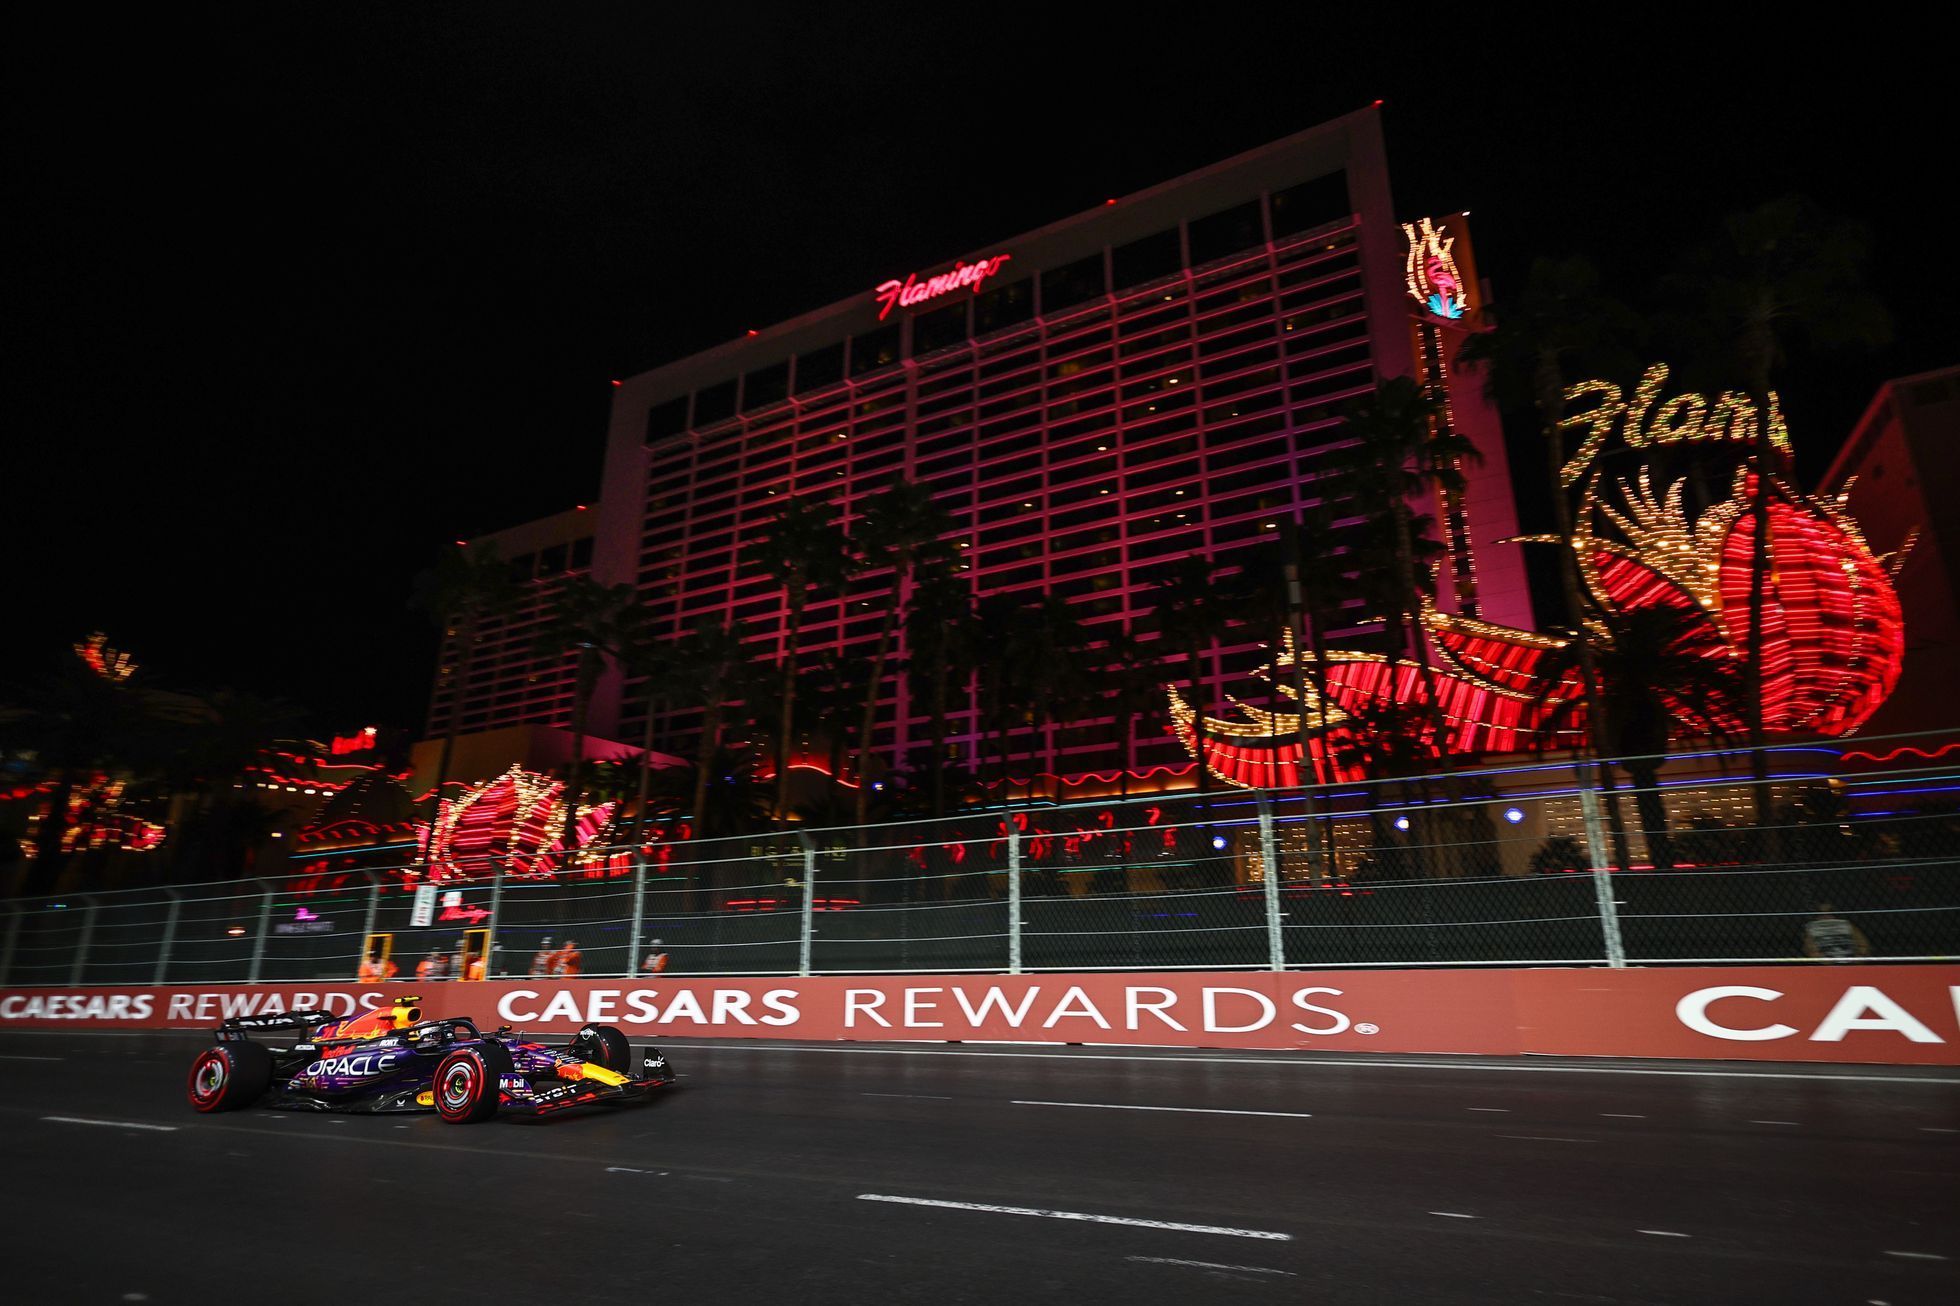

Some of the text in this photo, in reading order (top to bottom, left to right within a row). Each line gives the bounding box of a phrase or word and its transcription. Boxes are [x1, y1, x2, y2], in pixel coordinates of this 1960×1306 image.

[874, 252, 1012, 321] Flamingo
[1, 994, 154, 1020] CAESARS
[497, 989, 801, 1026] CAESARS
[1675, 985, 1960, 1044] CA
[306, 1055, 400, 1076] ORACLE
[499, 1078, 525, 1089] Mobil
